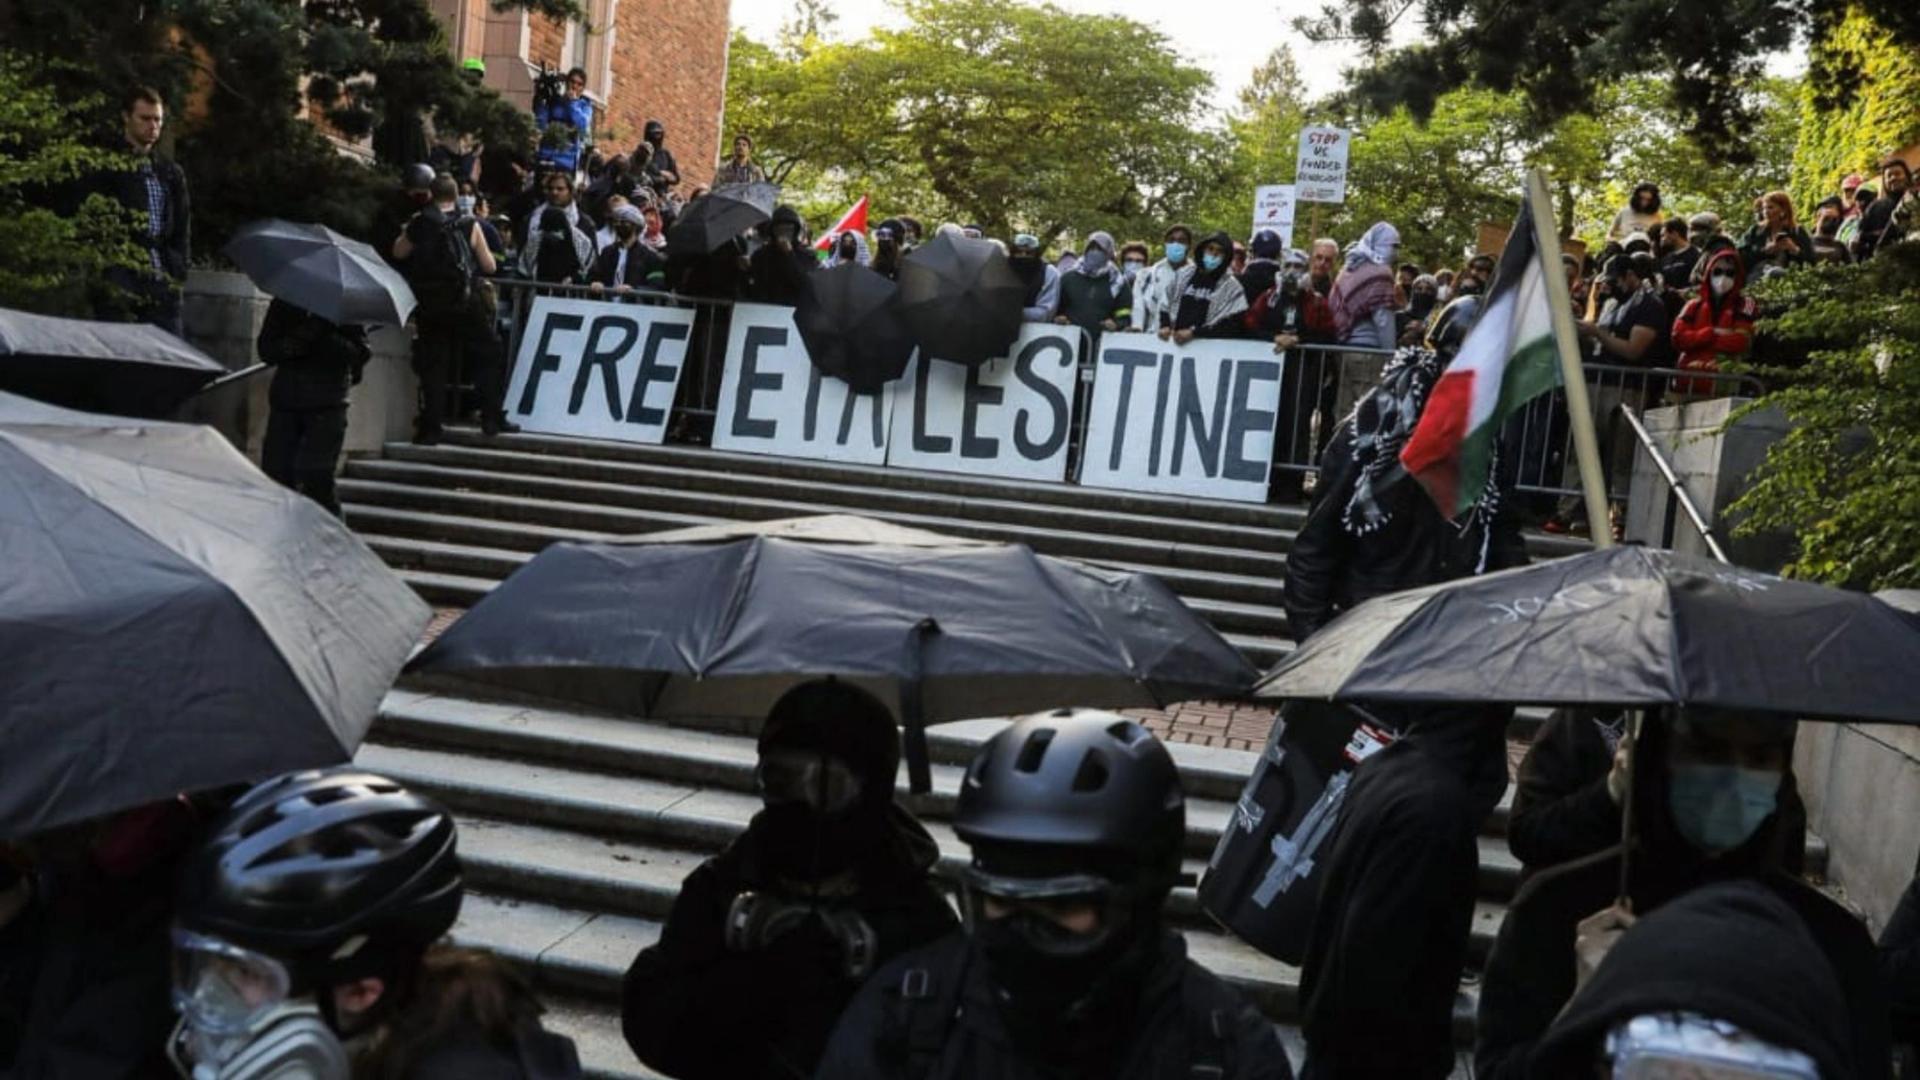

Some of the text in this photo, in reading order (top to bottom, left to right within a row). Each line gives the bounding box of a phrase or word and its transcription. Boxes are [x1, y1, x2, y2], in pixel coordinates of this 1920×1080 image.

[1308, 132, 1340, 145] STOP
[1313, 146, 1329, 157] US
[1301, 158, 1342, 171] FUNDED
